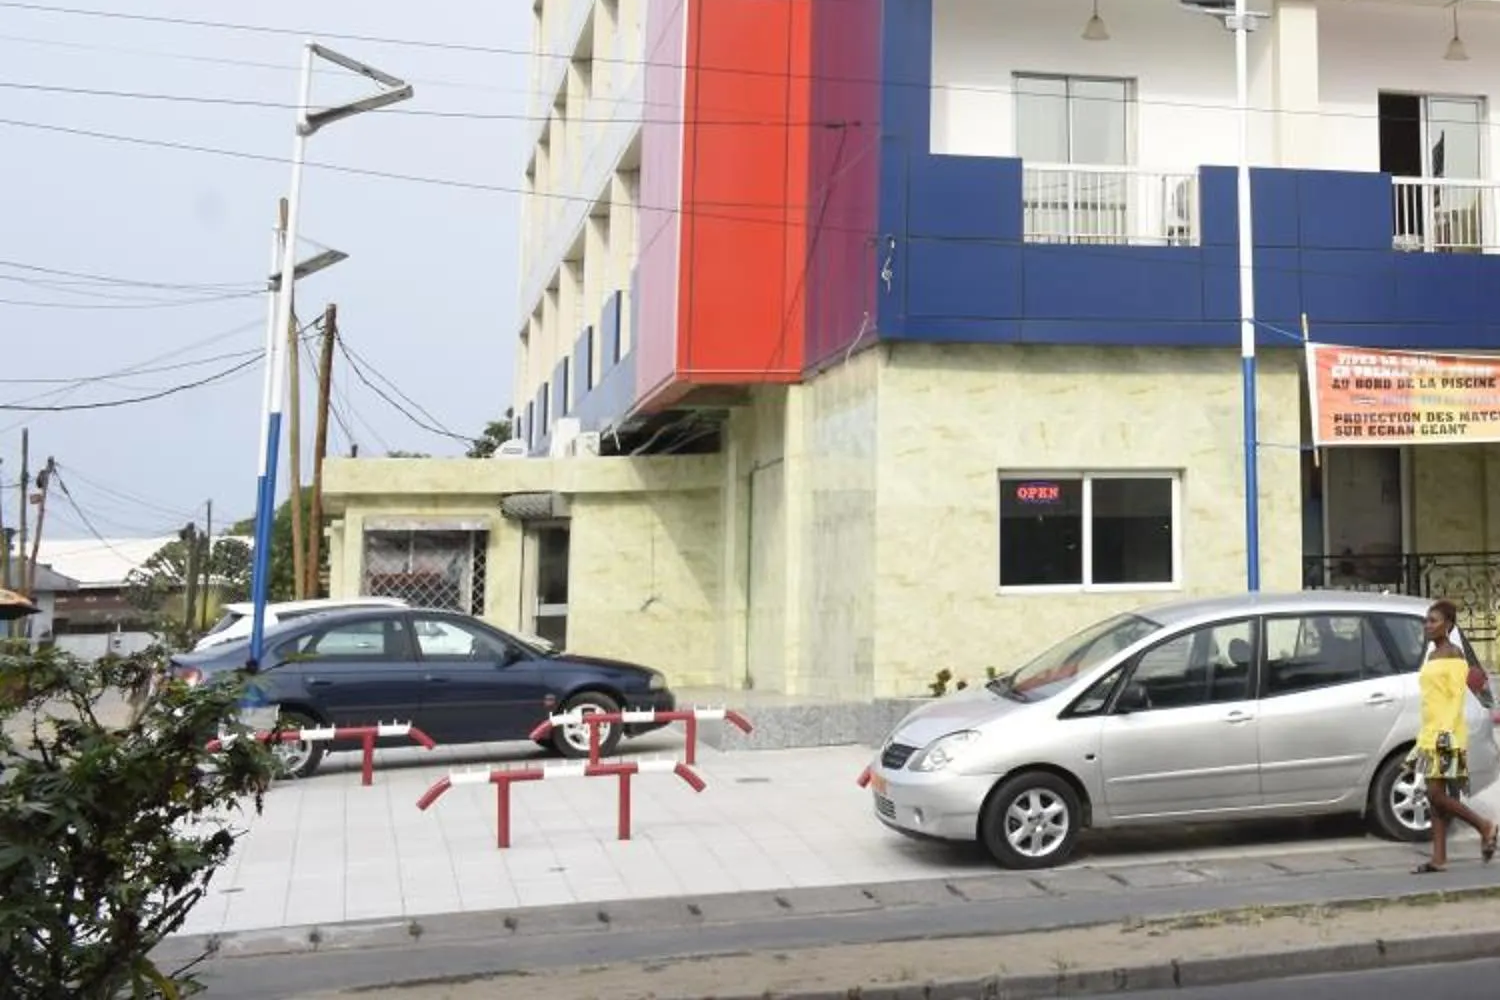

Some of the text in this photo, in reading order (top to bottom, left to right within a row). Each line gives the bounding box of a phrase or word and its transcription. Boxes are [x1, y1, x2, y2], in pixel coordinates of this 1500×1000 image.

[1331, 377, 1350, 389] AU
[1355, 377, 1392, 390] BORD
[1397, 377, 1415, 389] DE
[1419, 377, 1436, 389] LA
[1441, 376, 1497, 389] PISCINE
[1333, 411, 1421, 424] PROJECTION
[1426, 411, 1455, 423] DES
[1334, 423, 1468, 437] SUR ECRAN GEANT
[1017, 486, 1060, 499] OPEN
